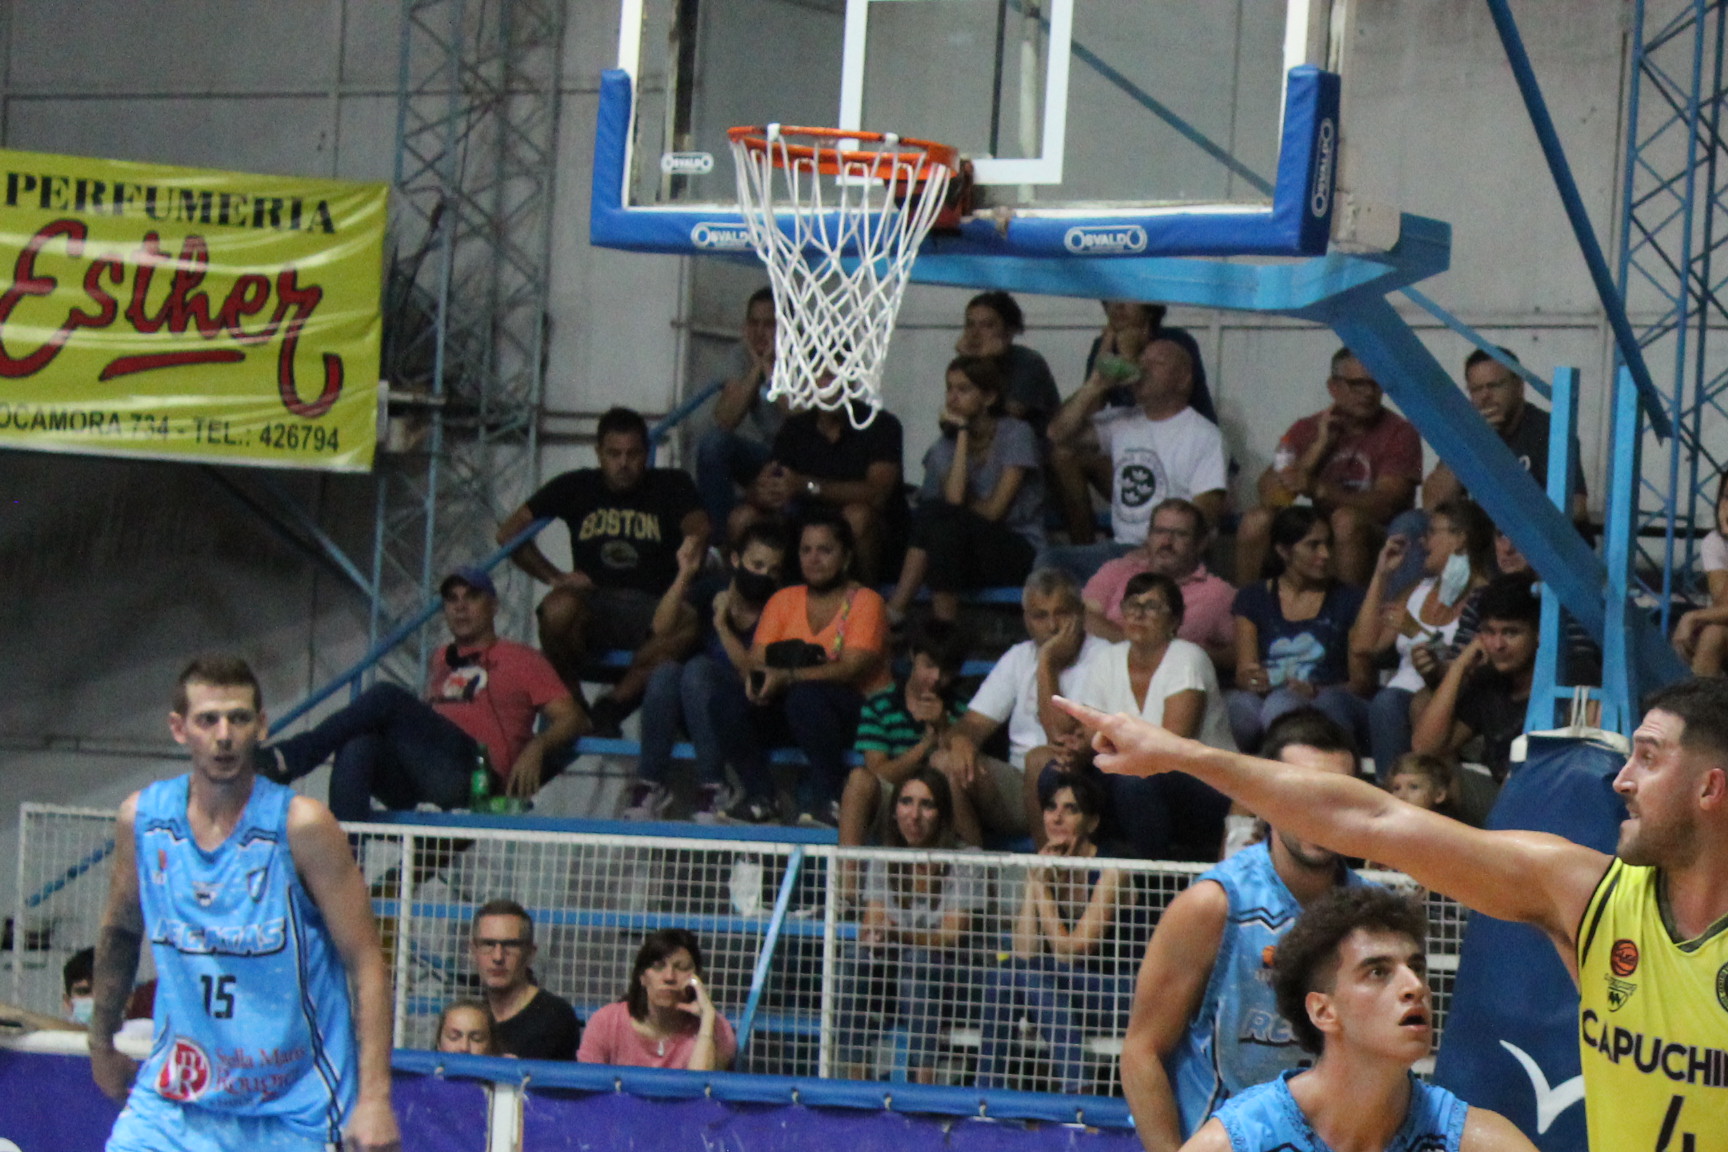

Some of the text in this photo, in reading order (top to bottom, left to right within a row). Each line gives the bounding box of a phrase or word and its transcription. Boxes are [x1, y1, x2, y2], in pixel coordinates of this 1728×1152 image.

[6, 172, 335, 234] PERFUMERIA
[1064, 225, 1148, 255] OSVALDO
[0, 219, 343, 418] Esther
[259, 425, 340, 452] 426794
[579, 508, 661, 542] BOSTON
[200, 974, 236, 1020] 15
